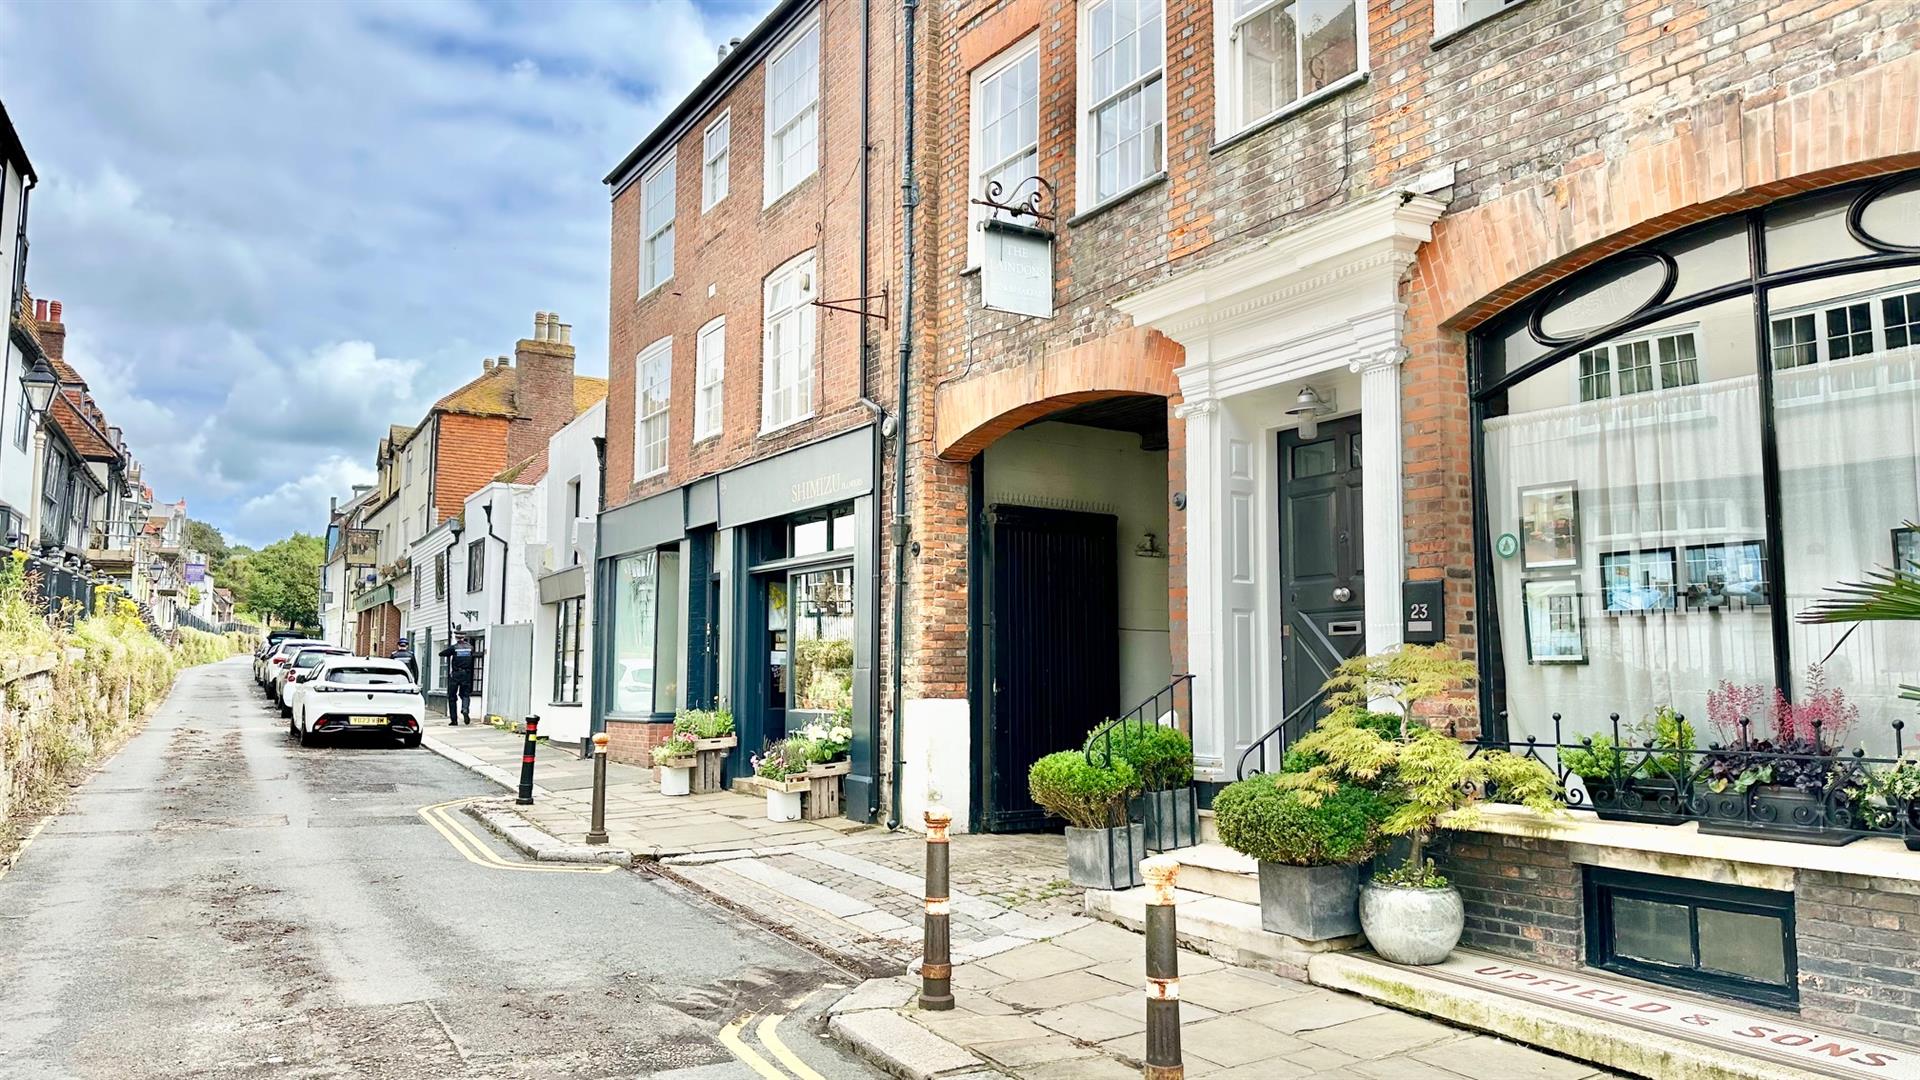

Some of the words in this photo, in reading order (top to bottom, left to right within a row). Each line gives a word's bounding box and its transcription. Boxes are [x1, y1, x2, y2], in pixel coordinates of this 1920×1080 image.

[1006, 245, 1029, 258] THE
[791, 473, 841, 504] SHIMIZU
[1410, 603, 1428, 619] 23
[1474, 965, 1672, 1013] UPFIELD
[1679, 1013, 1719, 1027] &
[1732, 1025, 1899, 1068] SONS
